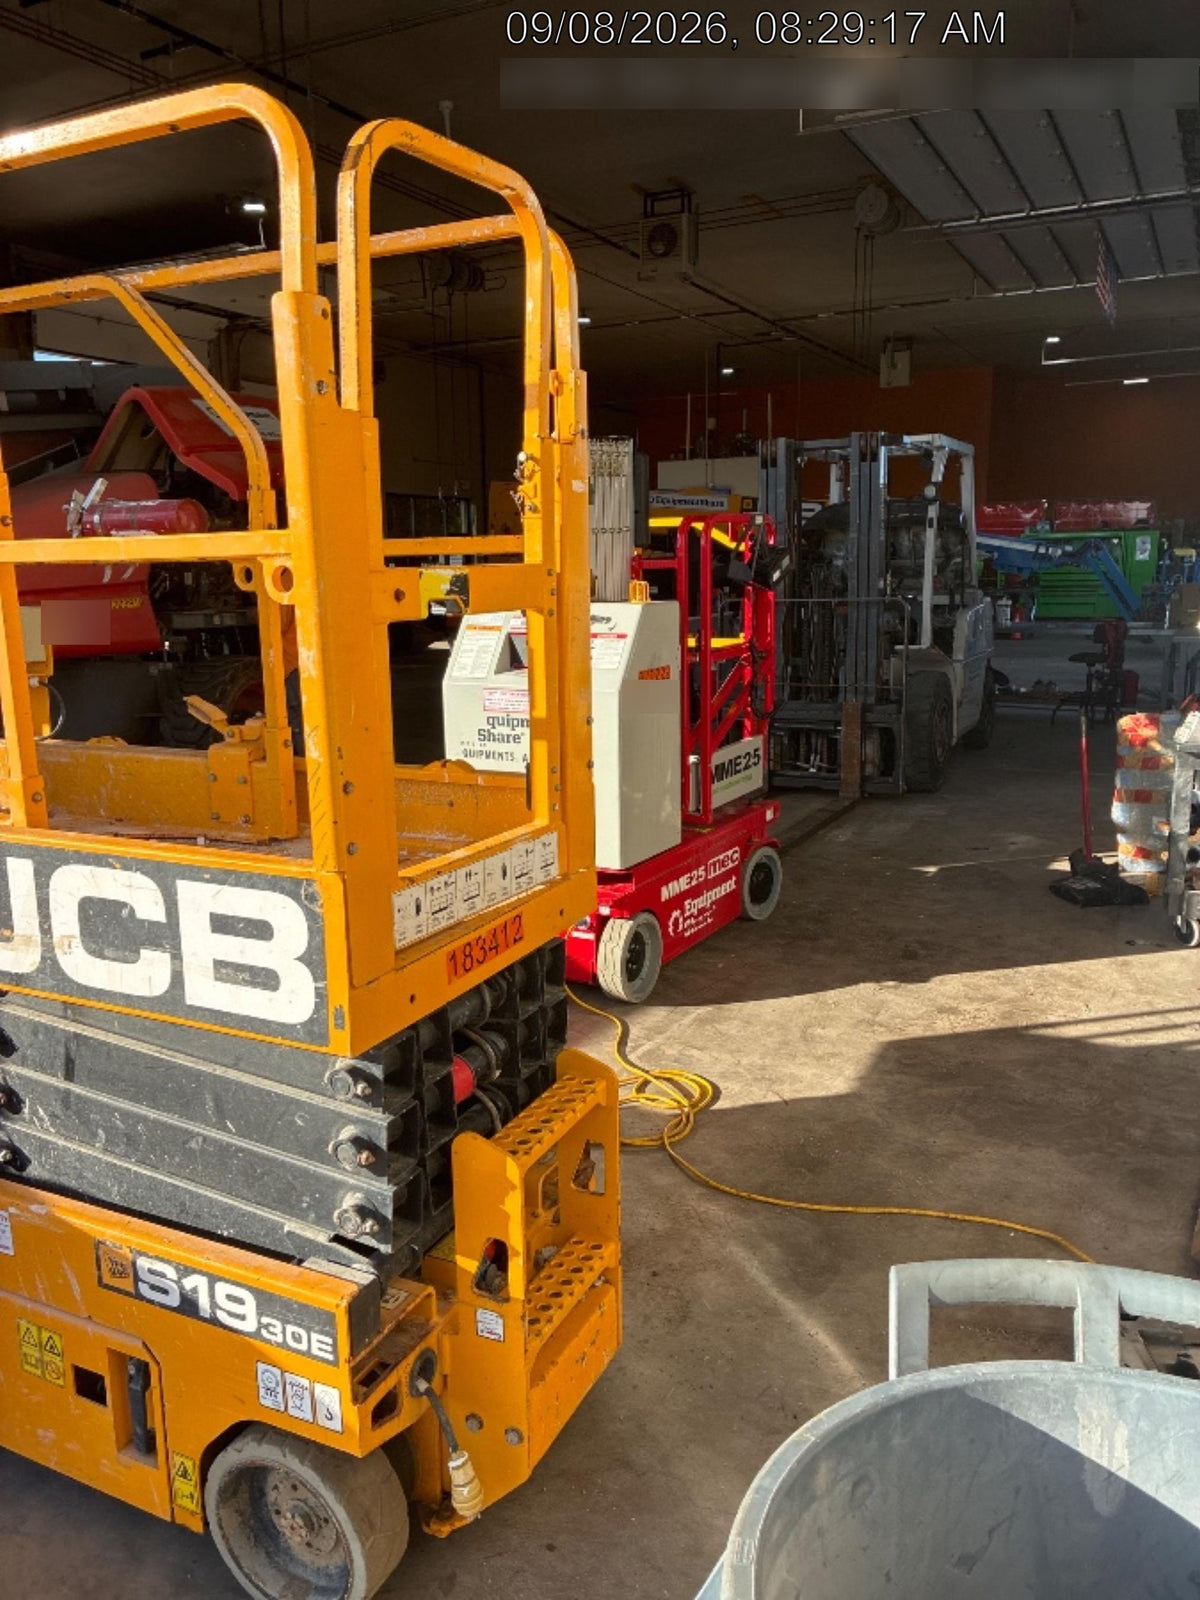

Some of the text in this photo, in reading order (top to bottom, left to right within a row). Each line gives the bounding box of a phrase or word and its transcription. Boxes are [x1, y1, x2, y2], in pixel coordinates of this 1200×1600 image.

[660, 865, 707, 903] MME25
[683, 874, 738, 918] Equipment
[0, 856, 316, 1025] JCB
[448, 913, 524, 977] 183412
